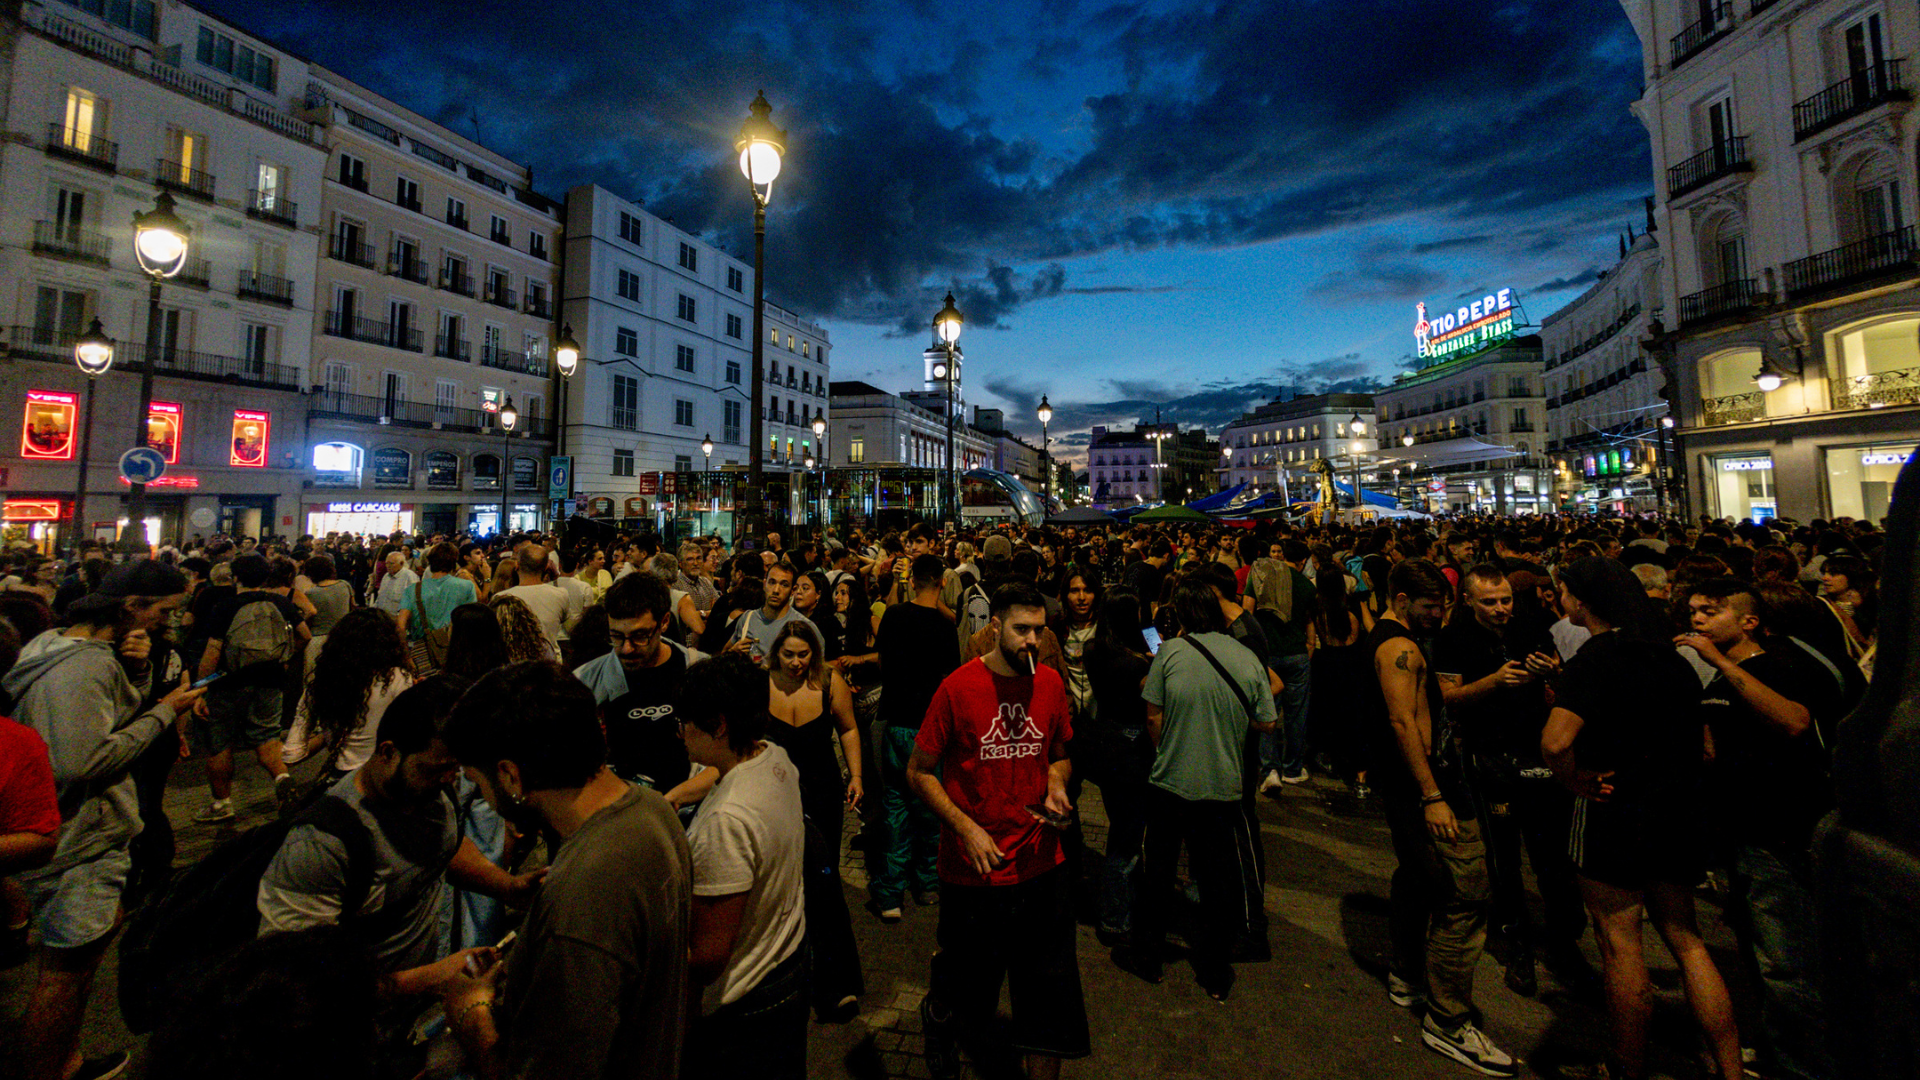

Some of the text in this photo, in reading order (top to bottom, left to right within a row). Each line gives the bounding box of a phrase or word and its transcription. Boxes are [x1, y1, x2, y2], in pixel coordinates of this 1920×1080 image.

[1430, 288, 1511, 337] TIO PEPE
[1432, 318, 1513, 358] GONZALEZ BYASS
[28, 394, 73, 403] VIPS
[234, 412, 265, 420] VIPS
[375, 456, 407, 464] COMPRO
[329, 503, 400, 512] MISS CARCASAS
[981, 743, 1042, 760] Kappa
